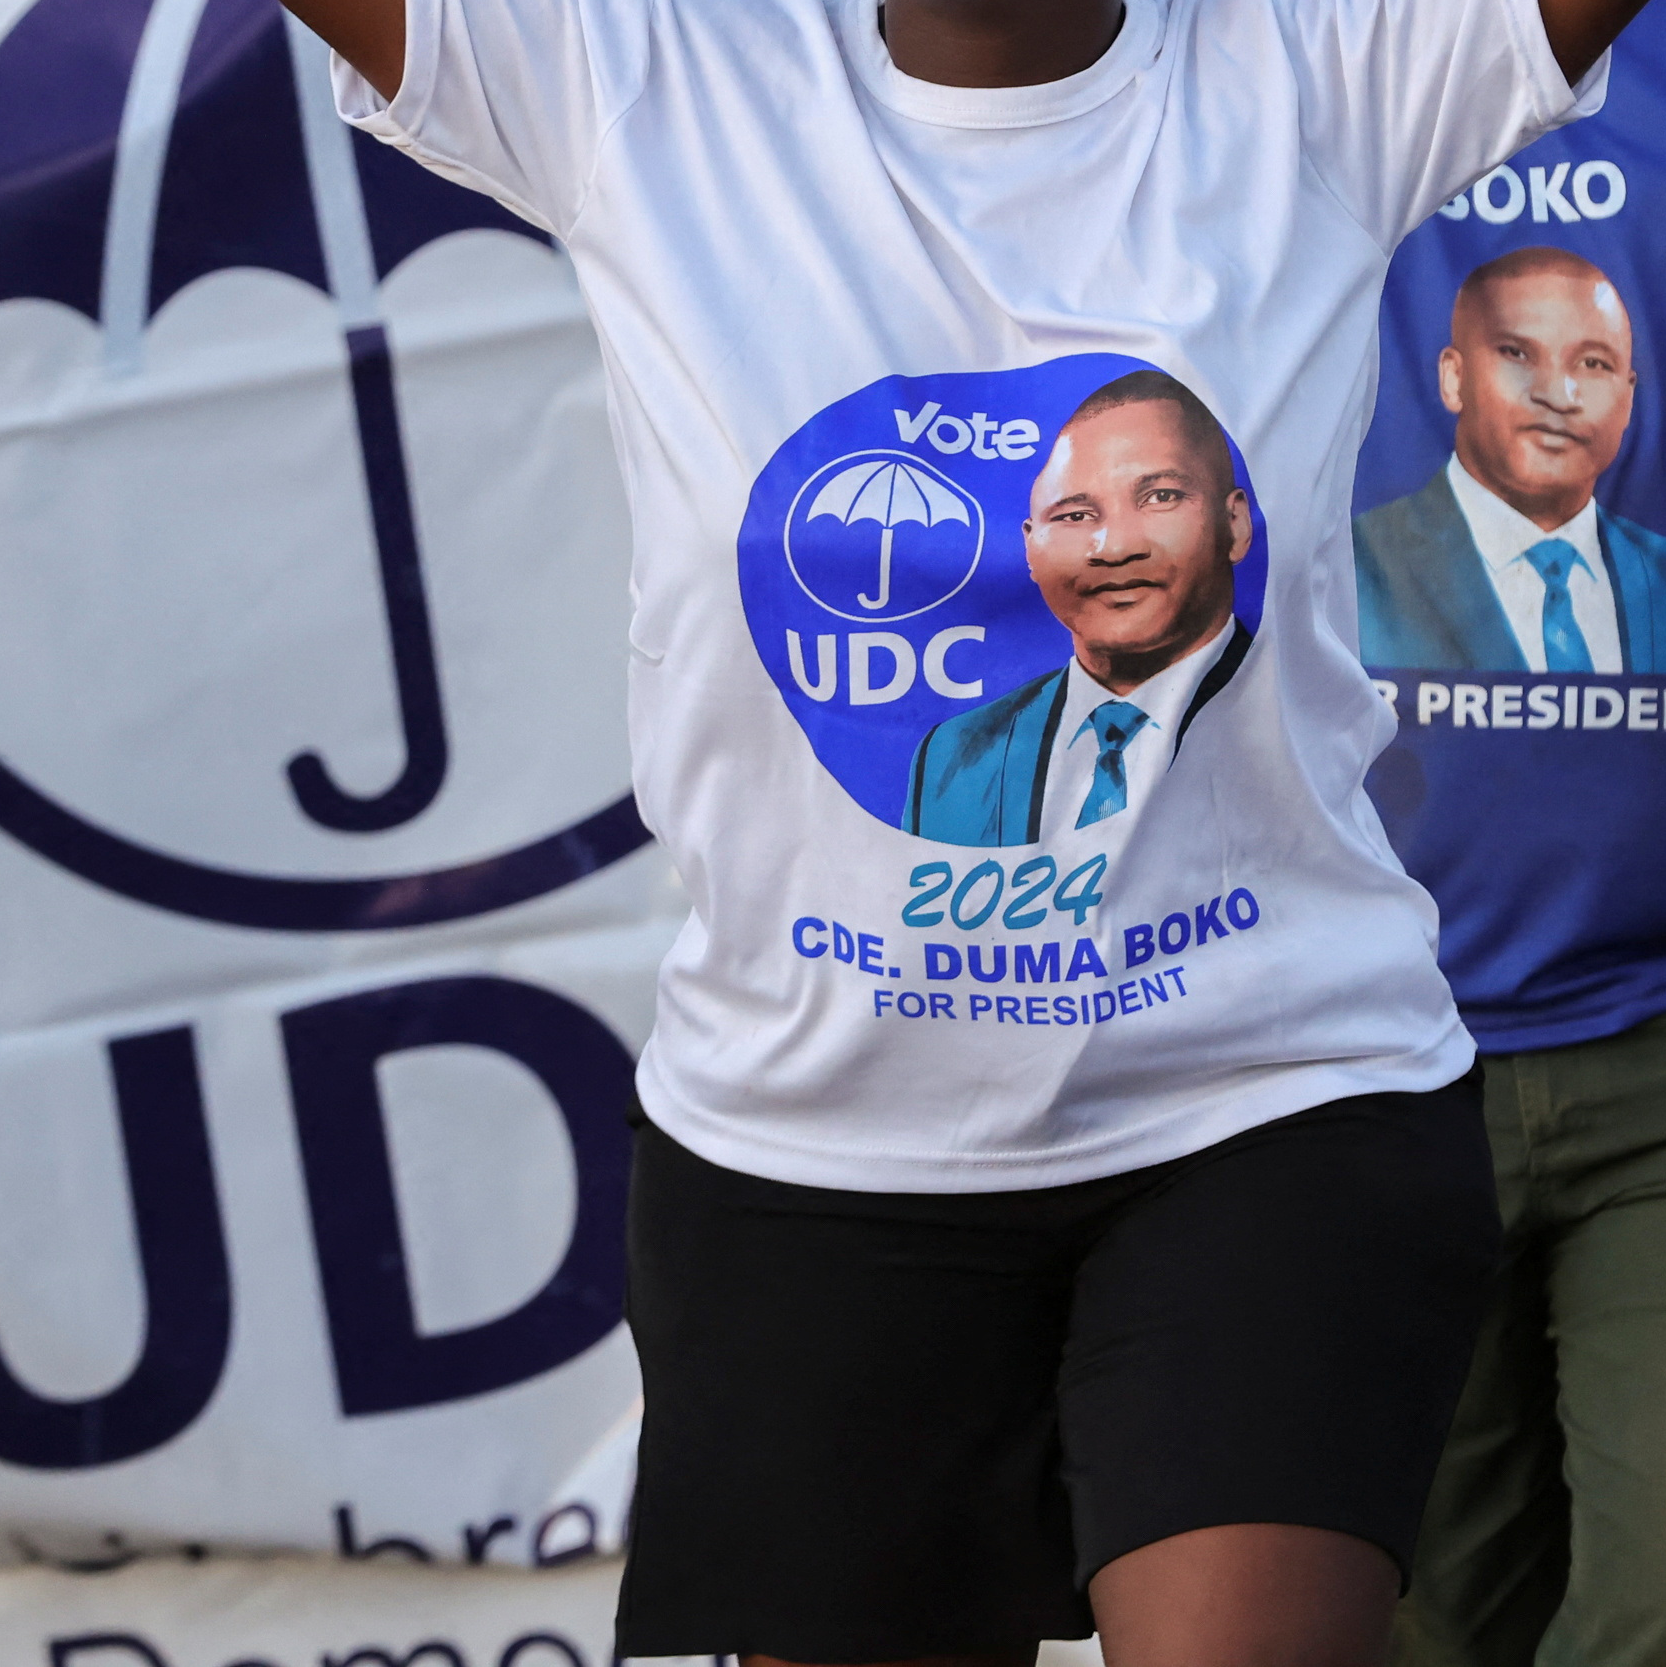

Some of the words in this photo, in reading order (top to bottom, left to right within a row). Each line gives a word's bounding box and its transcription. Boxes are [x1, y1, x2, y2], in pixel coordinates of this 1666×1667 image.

[786, 625, 985, 706] UDC
[901, 853, 1108, 931] 2024
[791, 916, 902, 979] CDE.
[924, 937, 1108, 984] DUMA
[1123, 887, 1260, 970] BOKO
[873, 990, 955, 1019] FOR
[969, 966, 1189, 1027] PRESIDENT
